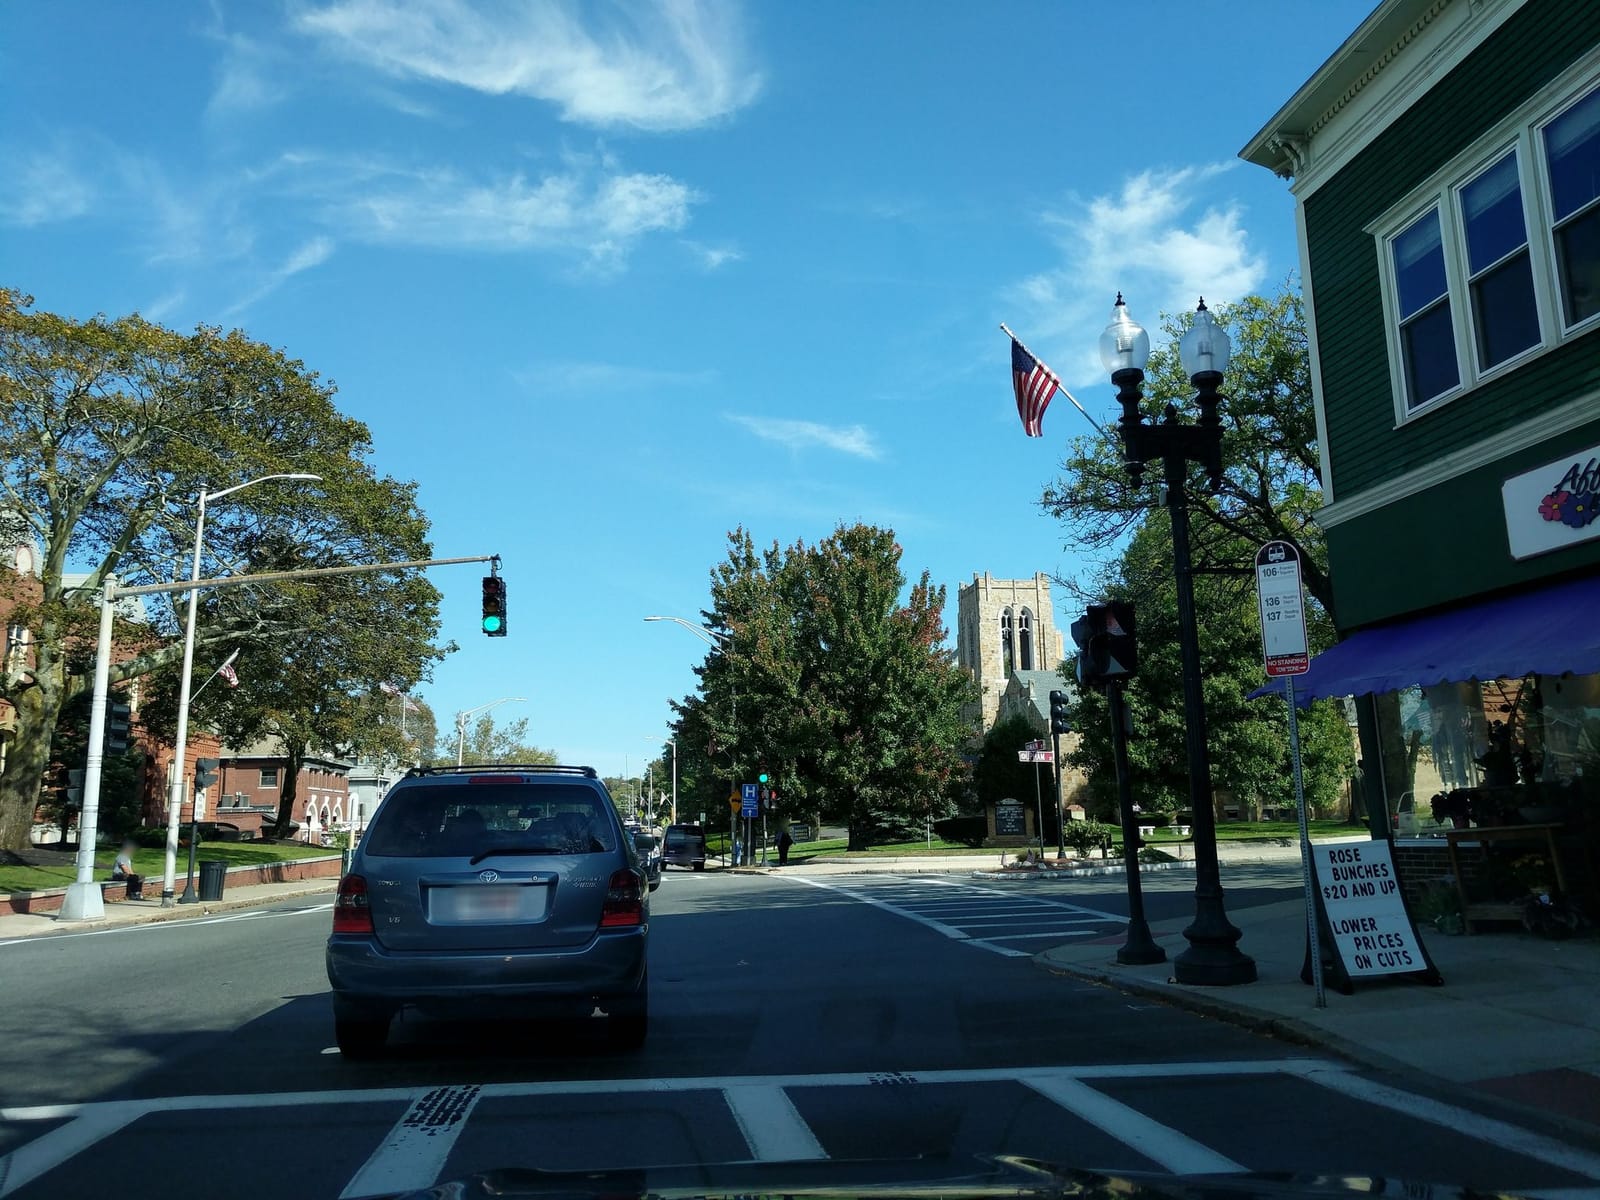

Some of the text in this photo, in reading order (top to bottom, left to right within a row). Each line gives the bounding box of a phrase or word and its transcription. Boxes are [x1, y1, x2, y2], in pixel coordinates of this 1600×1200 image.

[1262, 567, 1277, 578] 106
[1264, 596, 1280, 607] 136
[1266, 610, 1281, 621] 137
[1267, 659, 1277, 667] NO
[1277, 657, 1307, 666] STANDING
[745, 786, 756, 798] H
[1329, 848, 1361, 864] ROSE
[1332, 863, 1389, 881] BUNCHES
[1323, 880, 1396, 900] $20 AND UP
[1332, 917, 1378, 935] LOWER
[1354, 933, 1404, 951] PRICES
[1355, 950, 1413, 969] ON CUTS
